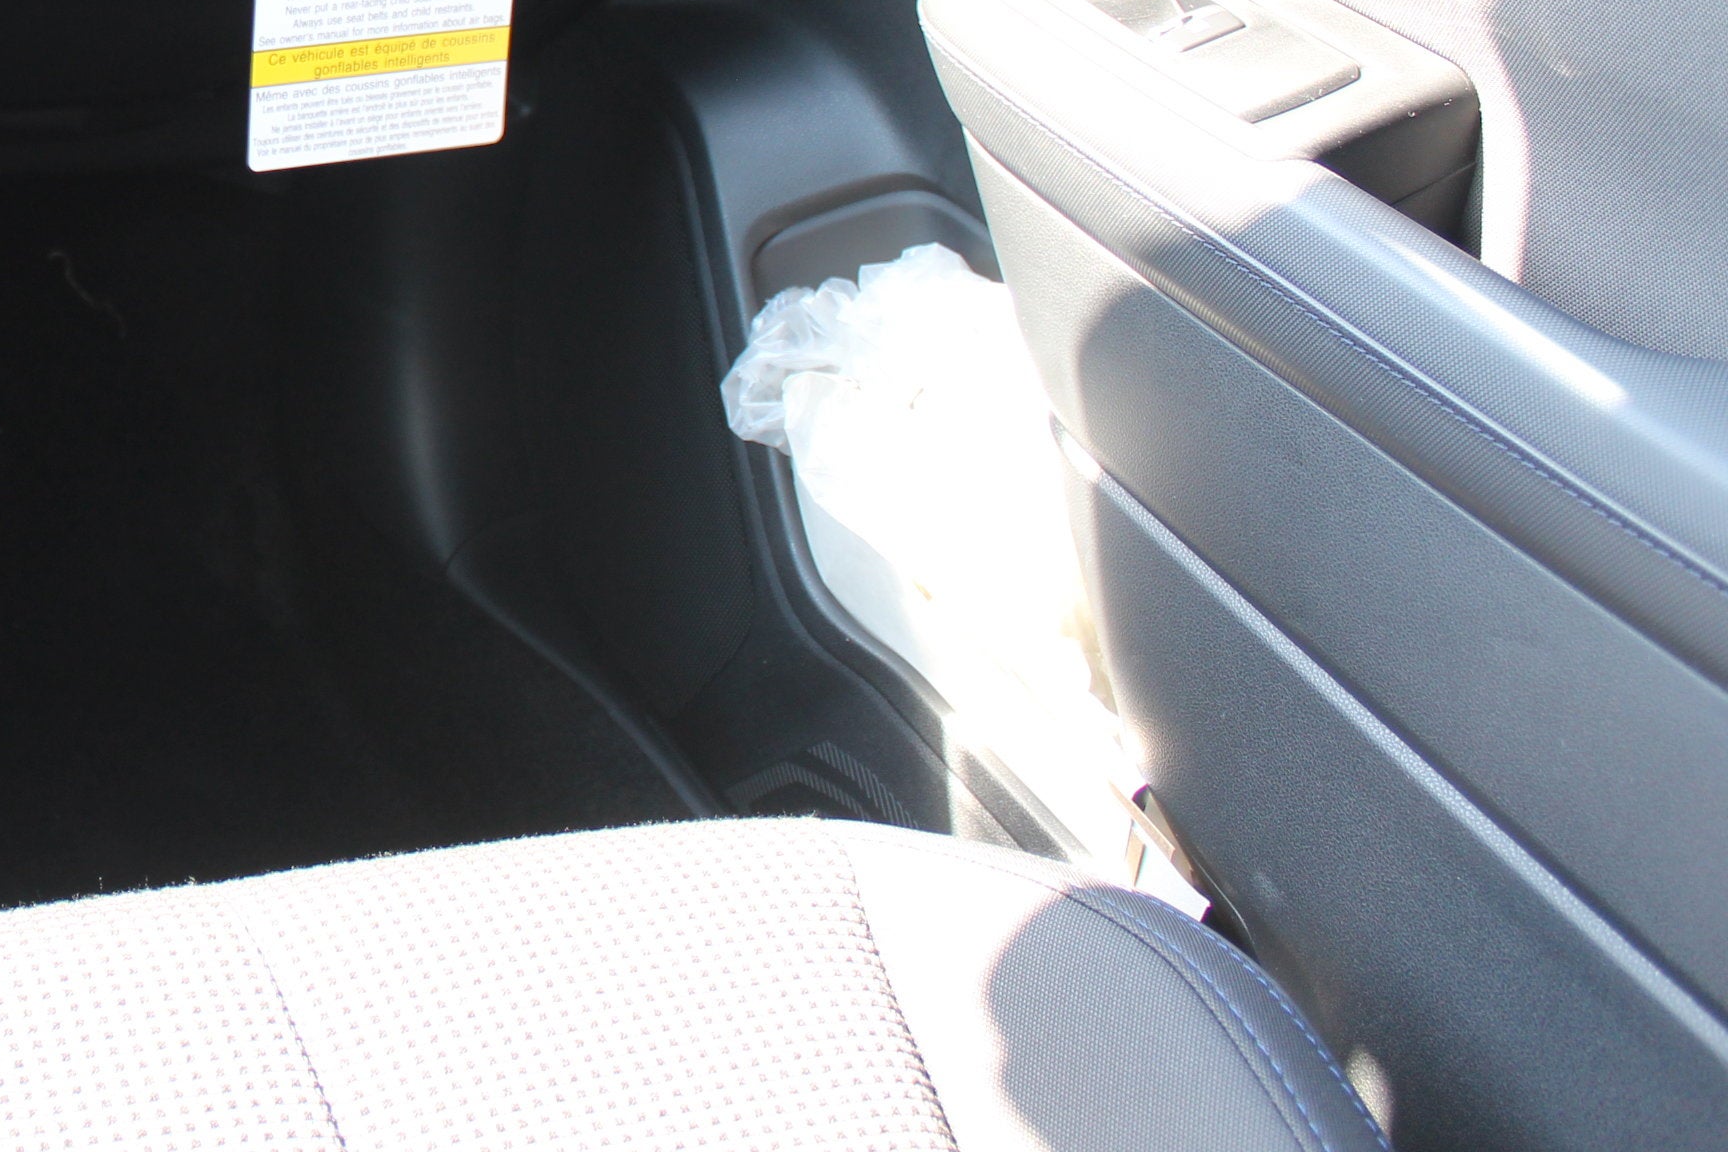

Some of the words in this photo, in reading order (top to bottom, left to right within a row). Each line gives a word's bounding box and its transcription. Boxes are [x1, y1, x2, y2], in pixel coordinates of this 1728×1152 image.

[286, 5, 310, 16] Never
[315, 3, 328, 14] put
[332, 3, 337, 11] a
[293, 19, 323, 29] Always
[327, 16, 342, 25] use
[346, 14, 364, 23] seat
[392, 8, 408, 18] and
[411, 6, 431, 16] child
[259, 36, 275, 47] See
[317, 30, 348, 40] manual
[352, 27, 363, 36] for
[368, 25, 389, 34] more
[393, 19, 439, 32] information
[442, 16, 465, 27] about
[469, 15, 479, 24] air
[268, 54, 286, 66] Ce
[293, 48, 344, 64] véhicule
[351, 45, 369, 56] est
[375, 39, 416, 58] équipé
[423, 39, 437, 49] de
[442, 33, 495, 48] coussins
[314, 61, 378, 79] gonflables
[385, 52, 449, 68] intelligents
[293, 88, 317, 98] avec
[322, 85, 340, 95] des
[345, 80, 389, 92] coussins
[394, 72, 445, 88] gonflables
[450, 67, 501, 81] intelligents
